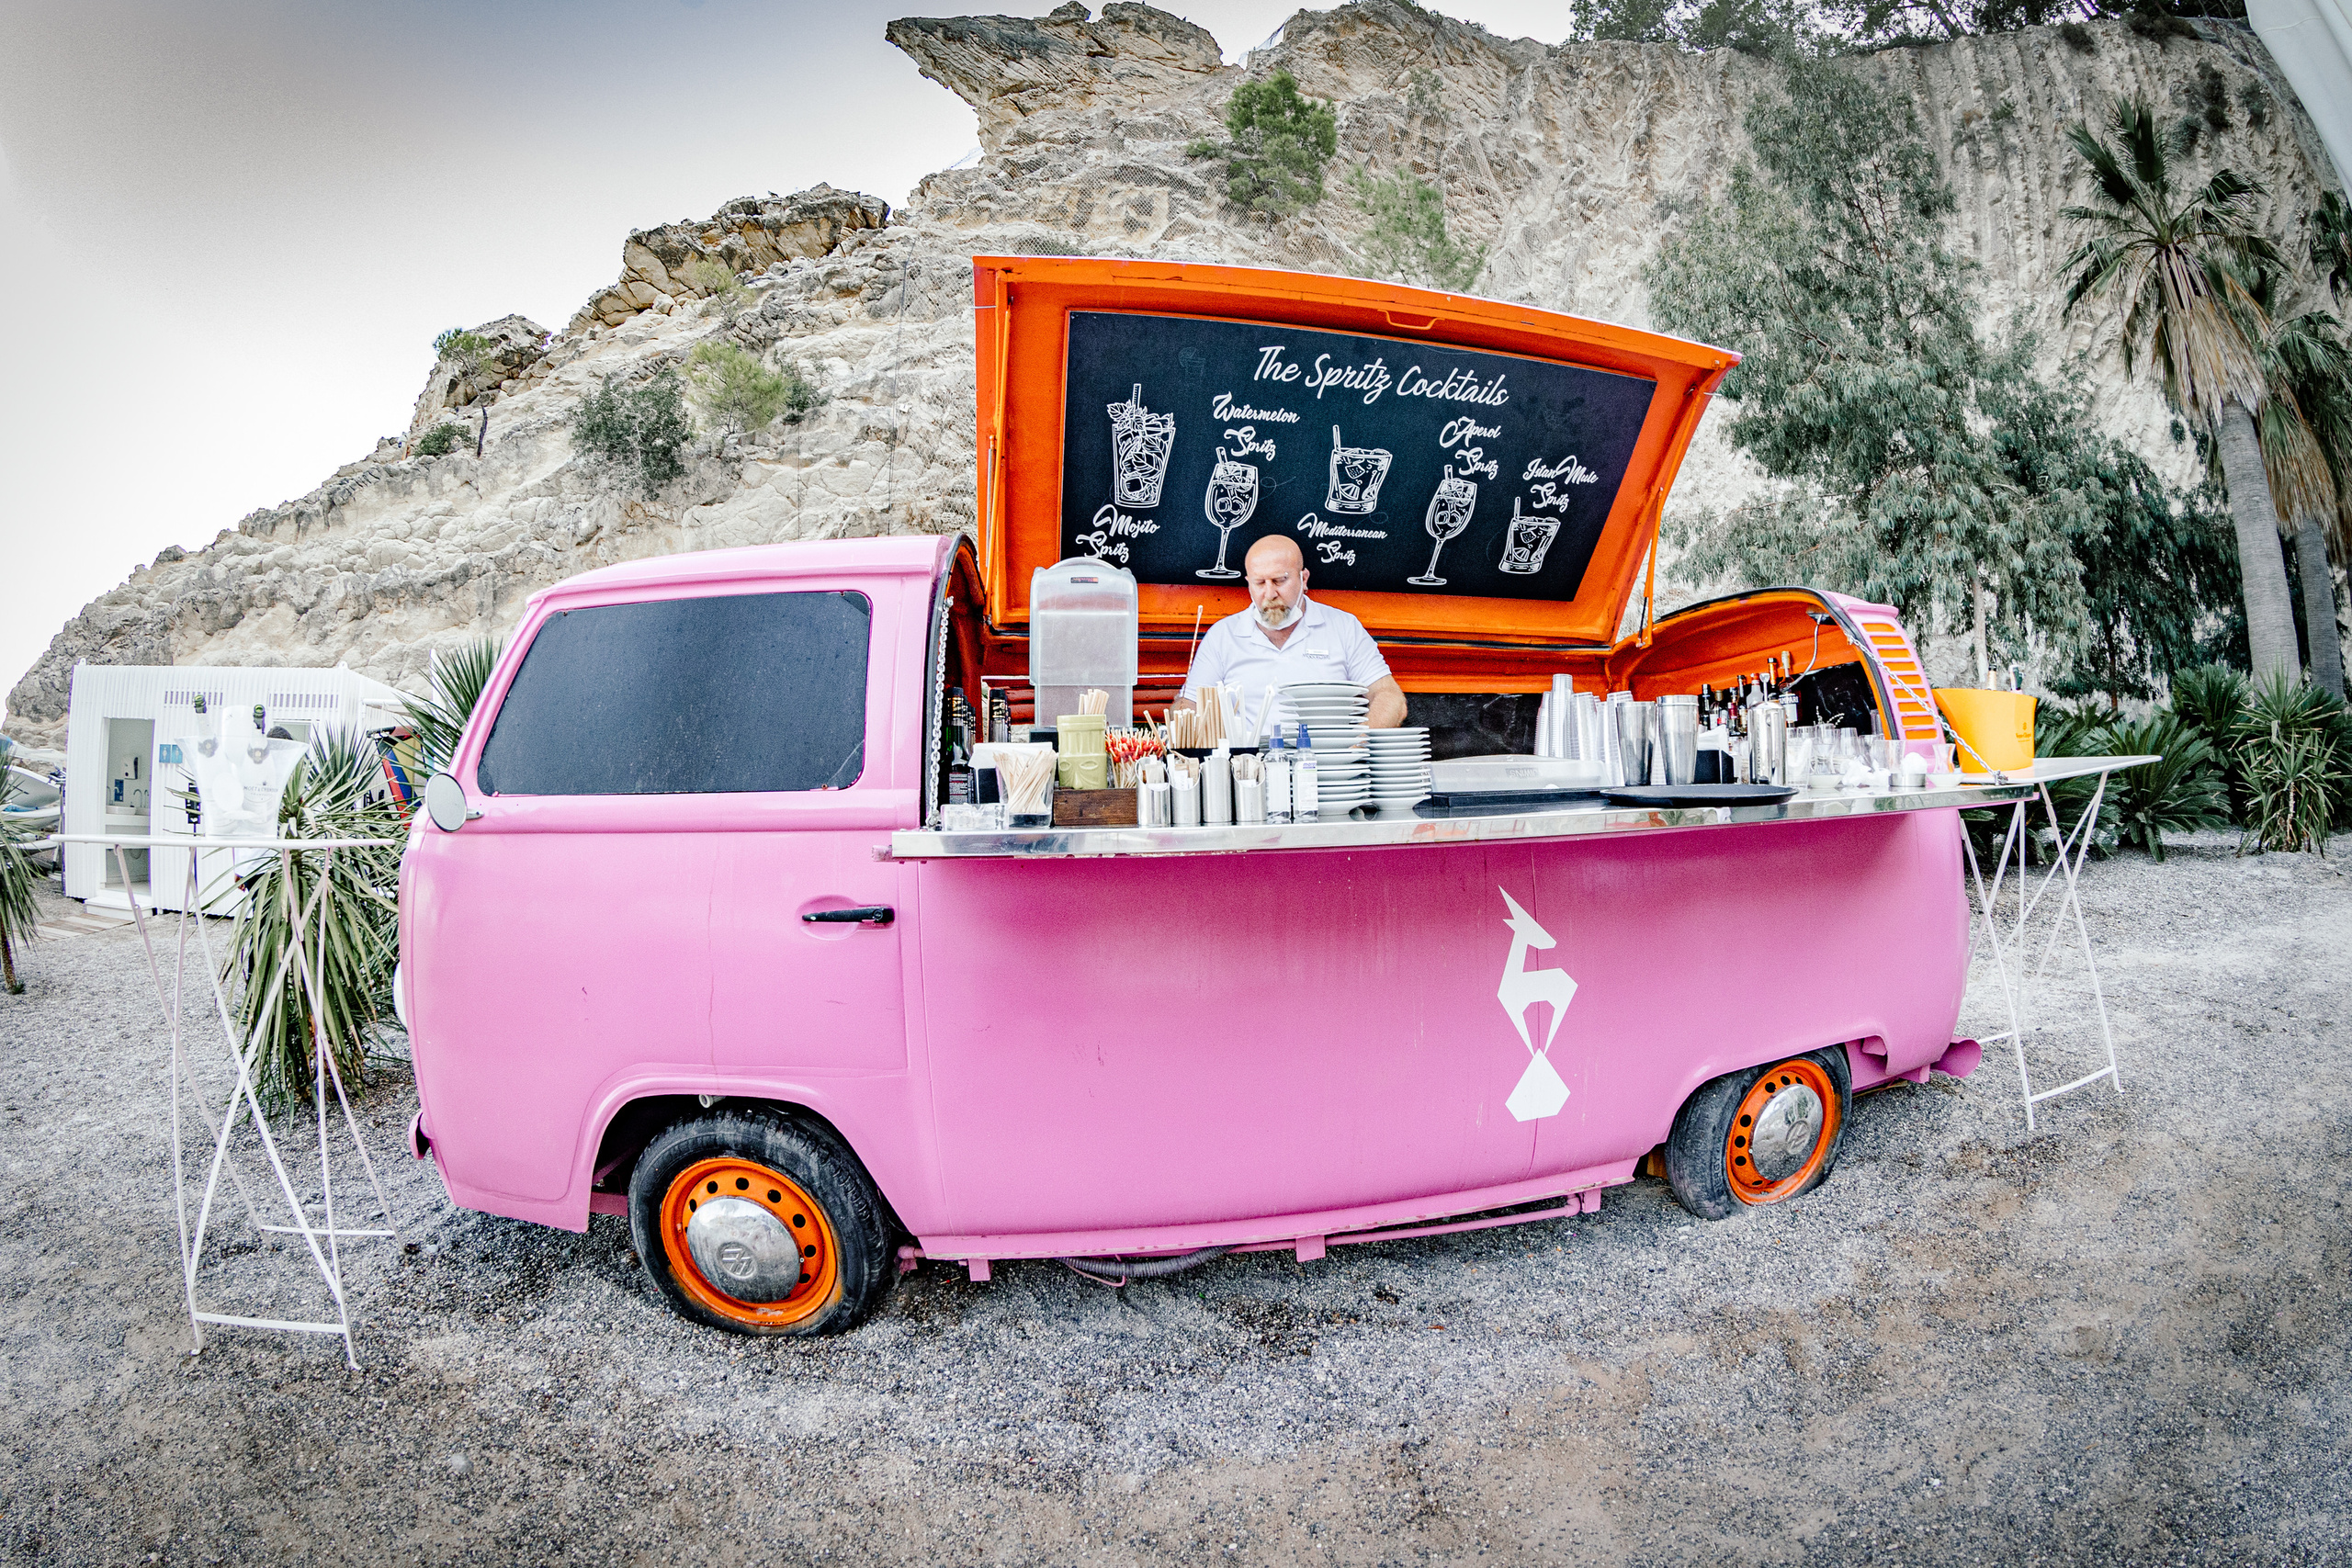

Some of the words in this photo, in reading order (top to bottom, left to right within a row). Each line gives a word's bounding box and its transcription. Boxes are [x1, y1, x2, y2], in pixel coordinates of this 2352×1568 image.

[1253, 345, 1301, 382] The
[1305, 353, 1393, 405] Spritz
[1396, 365, 1510, 406] Cocktails
[1213, 390, 1300, 423] Watermelon
[1224, 425, 1276, 461] Spritz
[1439, 416, 1502, 448] Aperol
[1454, 446, 1499, 480] Spritz
[1530, 481, 1570, 513] Spritz
[1092, 503, 1160, 538] Mojito
[1296, 512, 1388, 539] Mediterranean
[1075, 530, 1130, 564] Spritz
[1316, 540, 1356, 567] Spritz
